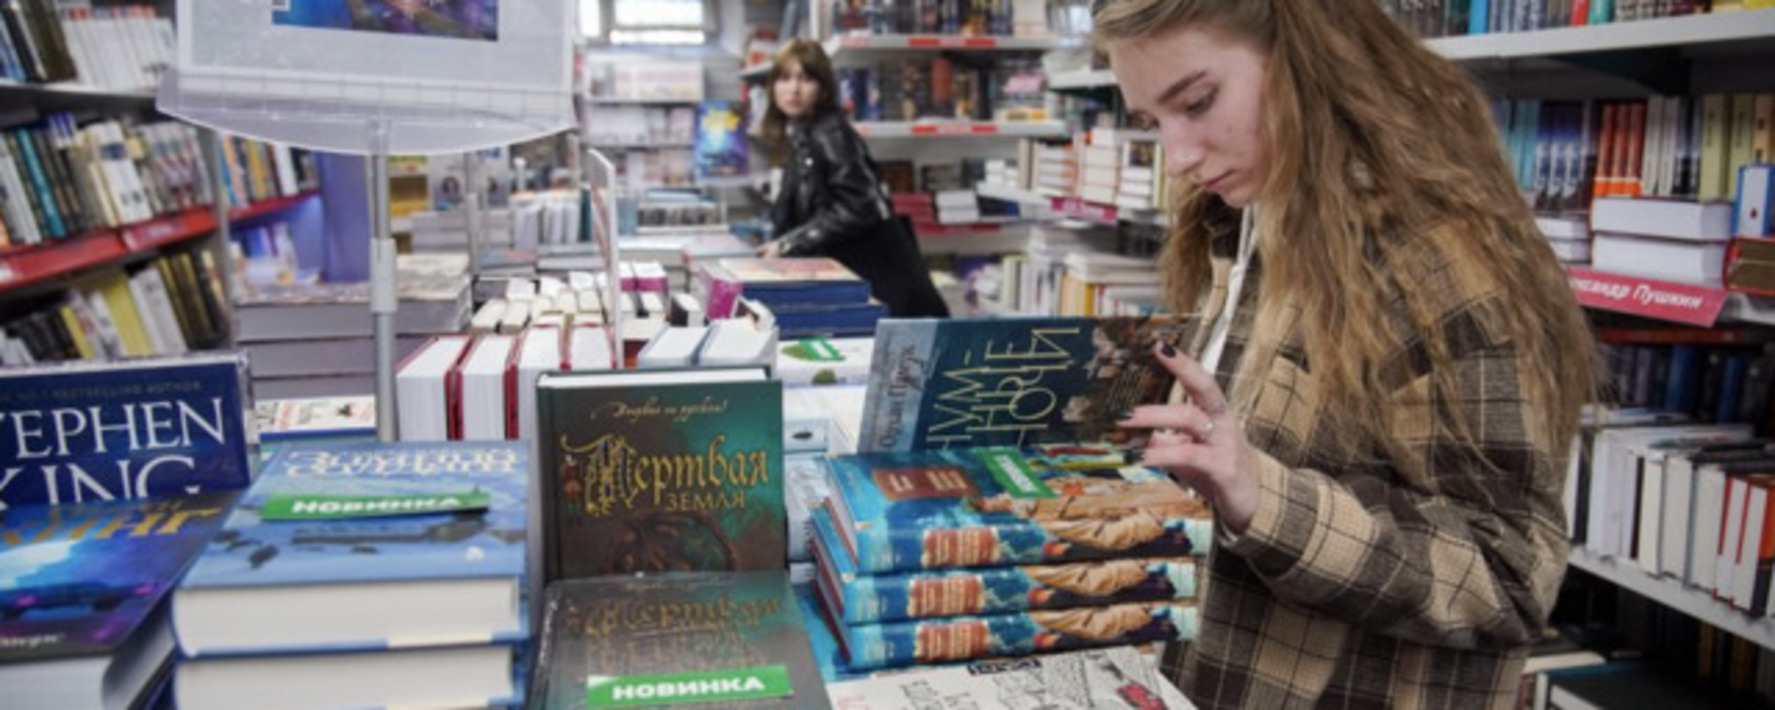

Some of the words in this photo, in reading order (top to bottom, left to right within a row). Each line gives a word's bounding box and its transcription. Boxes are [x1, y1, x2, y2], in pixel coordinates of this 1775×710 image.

[1633, 283, 1704, 310] Пушкин
[289, 496, 464, 515] НОВИНКА
[664, 490, 747, 512] ЗЕМЛЯ
[611, 675, 765, 700] НОВИНКА
